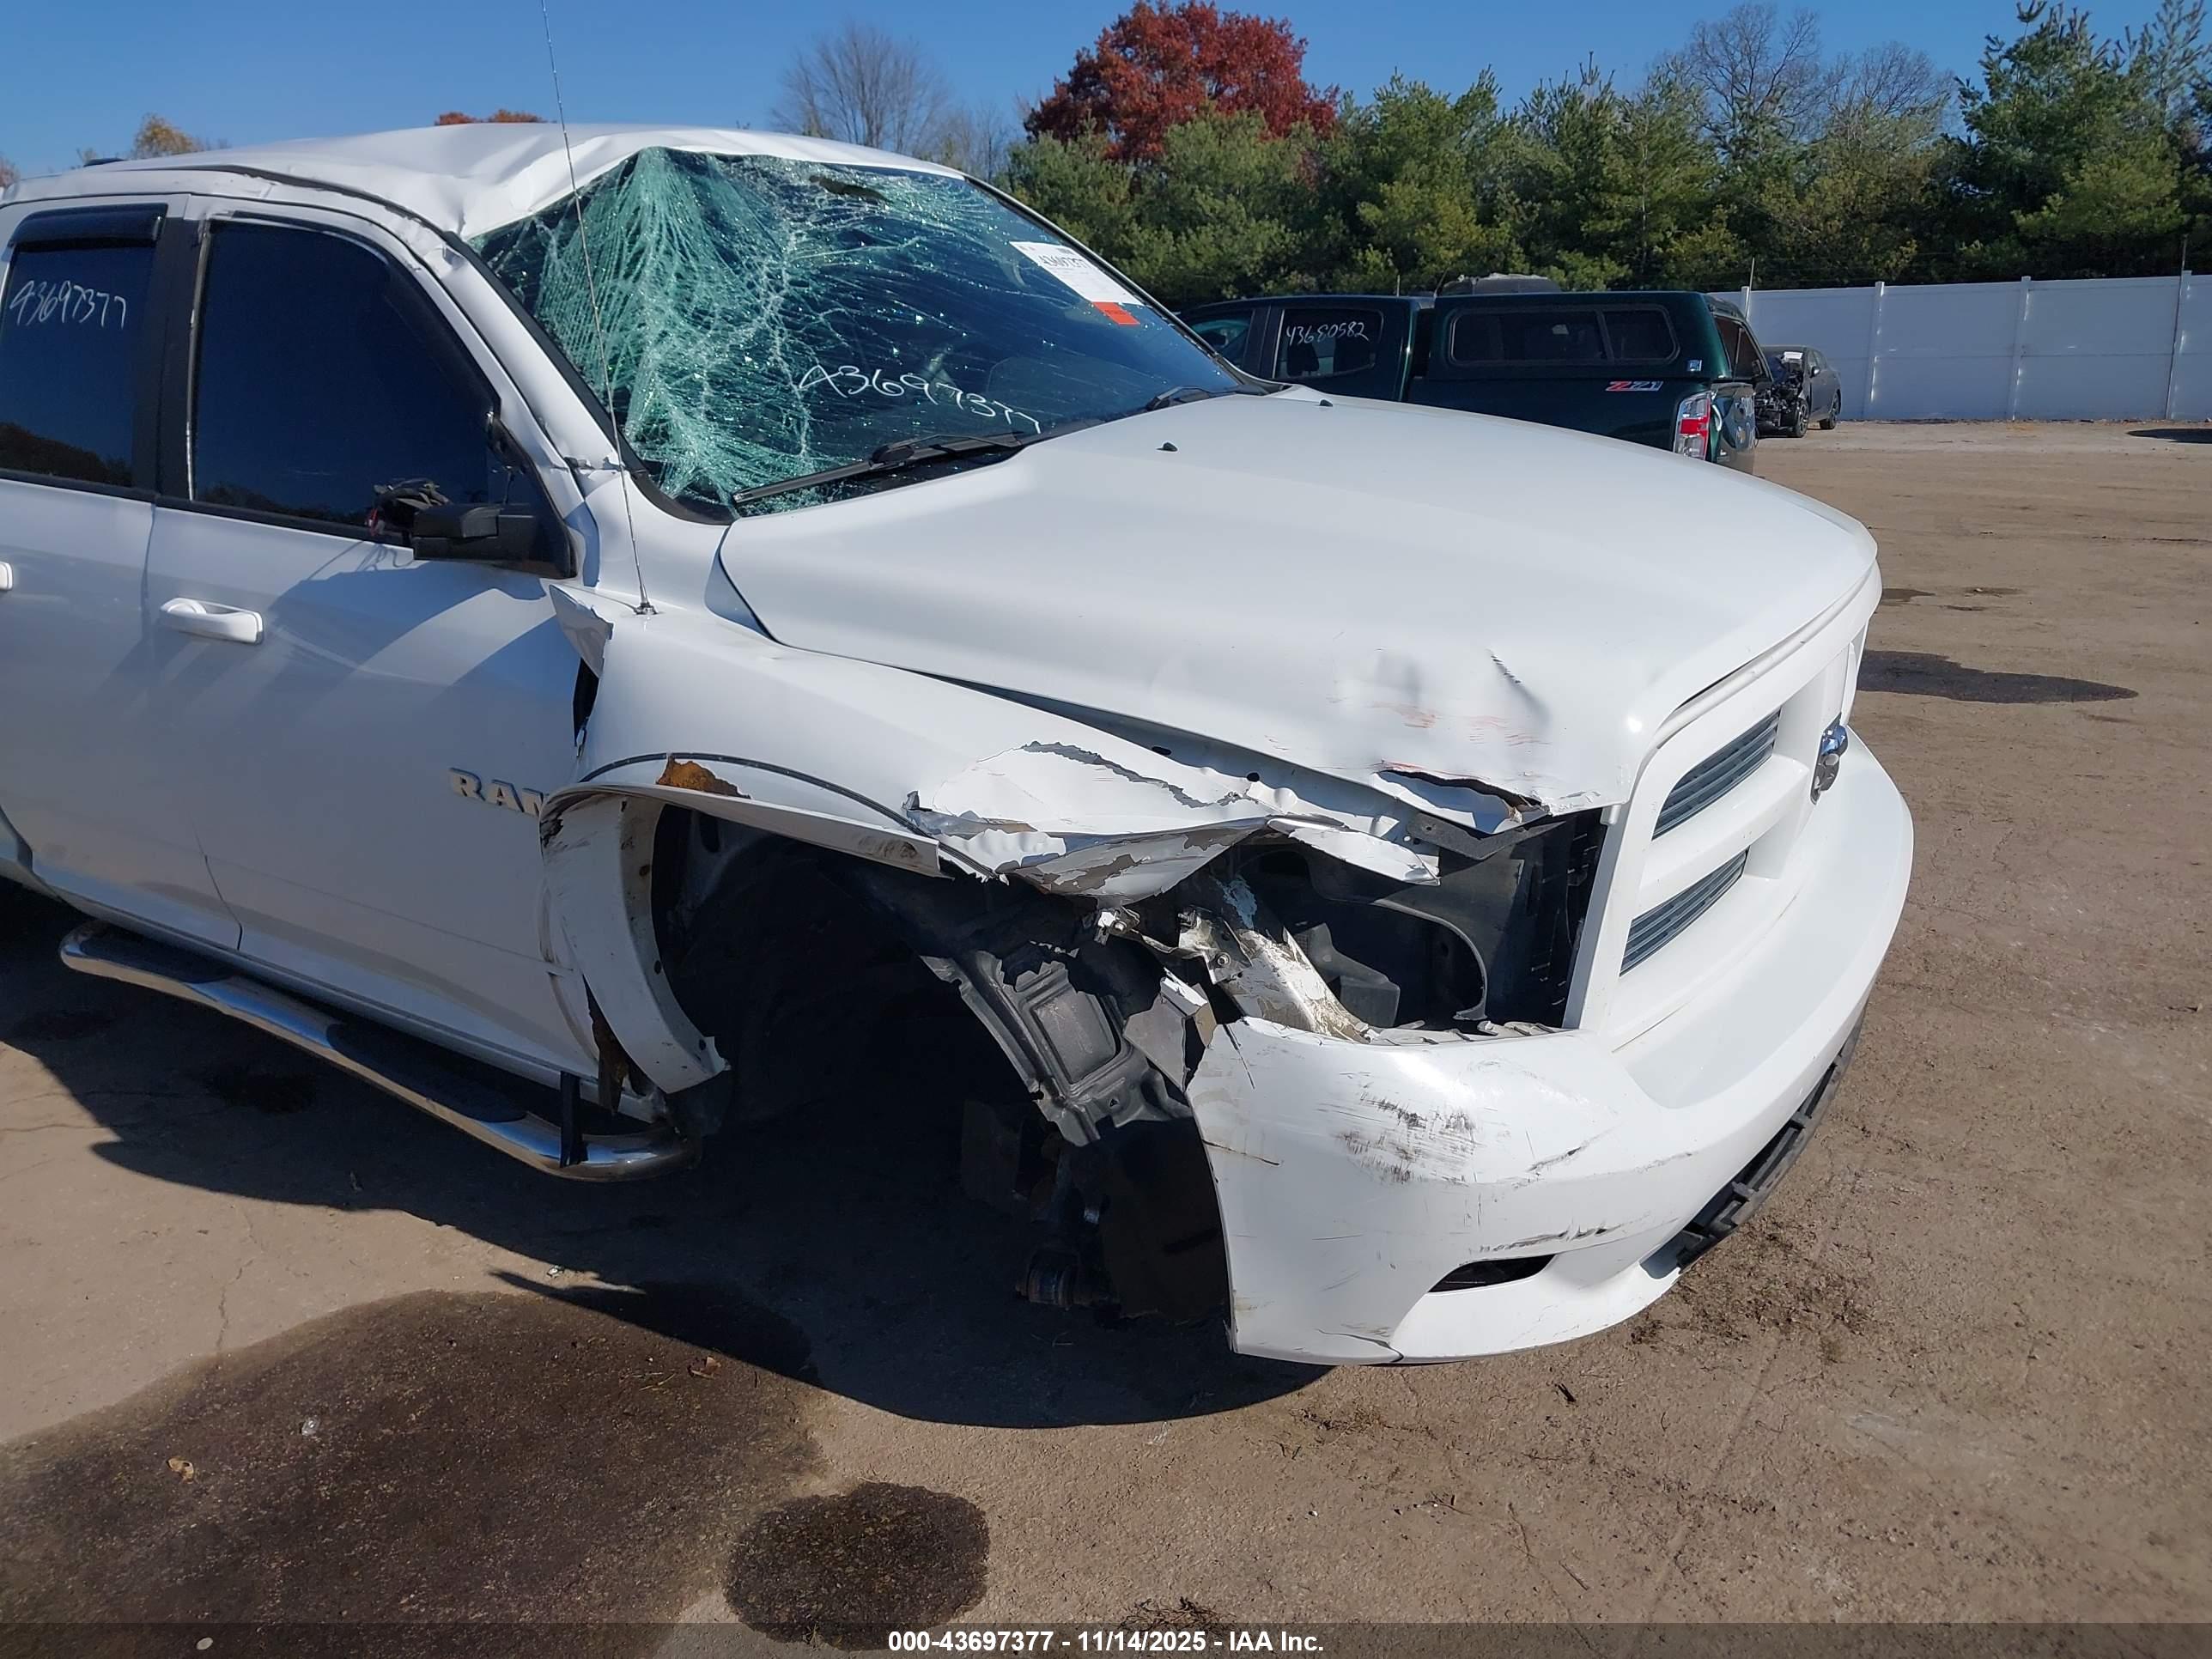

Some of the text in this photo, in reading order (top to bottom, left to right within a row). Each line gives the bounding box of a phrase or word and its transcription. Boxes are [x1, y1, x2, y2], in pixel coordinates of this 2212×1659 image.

[9, 280, 126, 330] 43697377
[1286, 320, 1370, 346] 43680582
[799, 364, 1042, 434] 43697377
